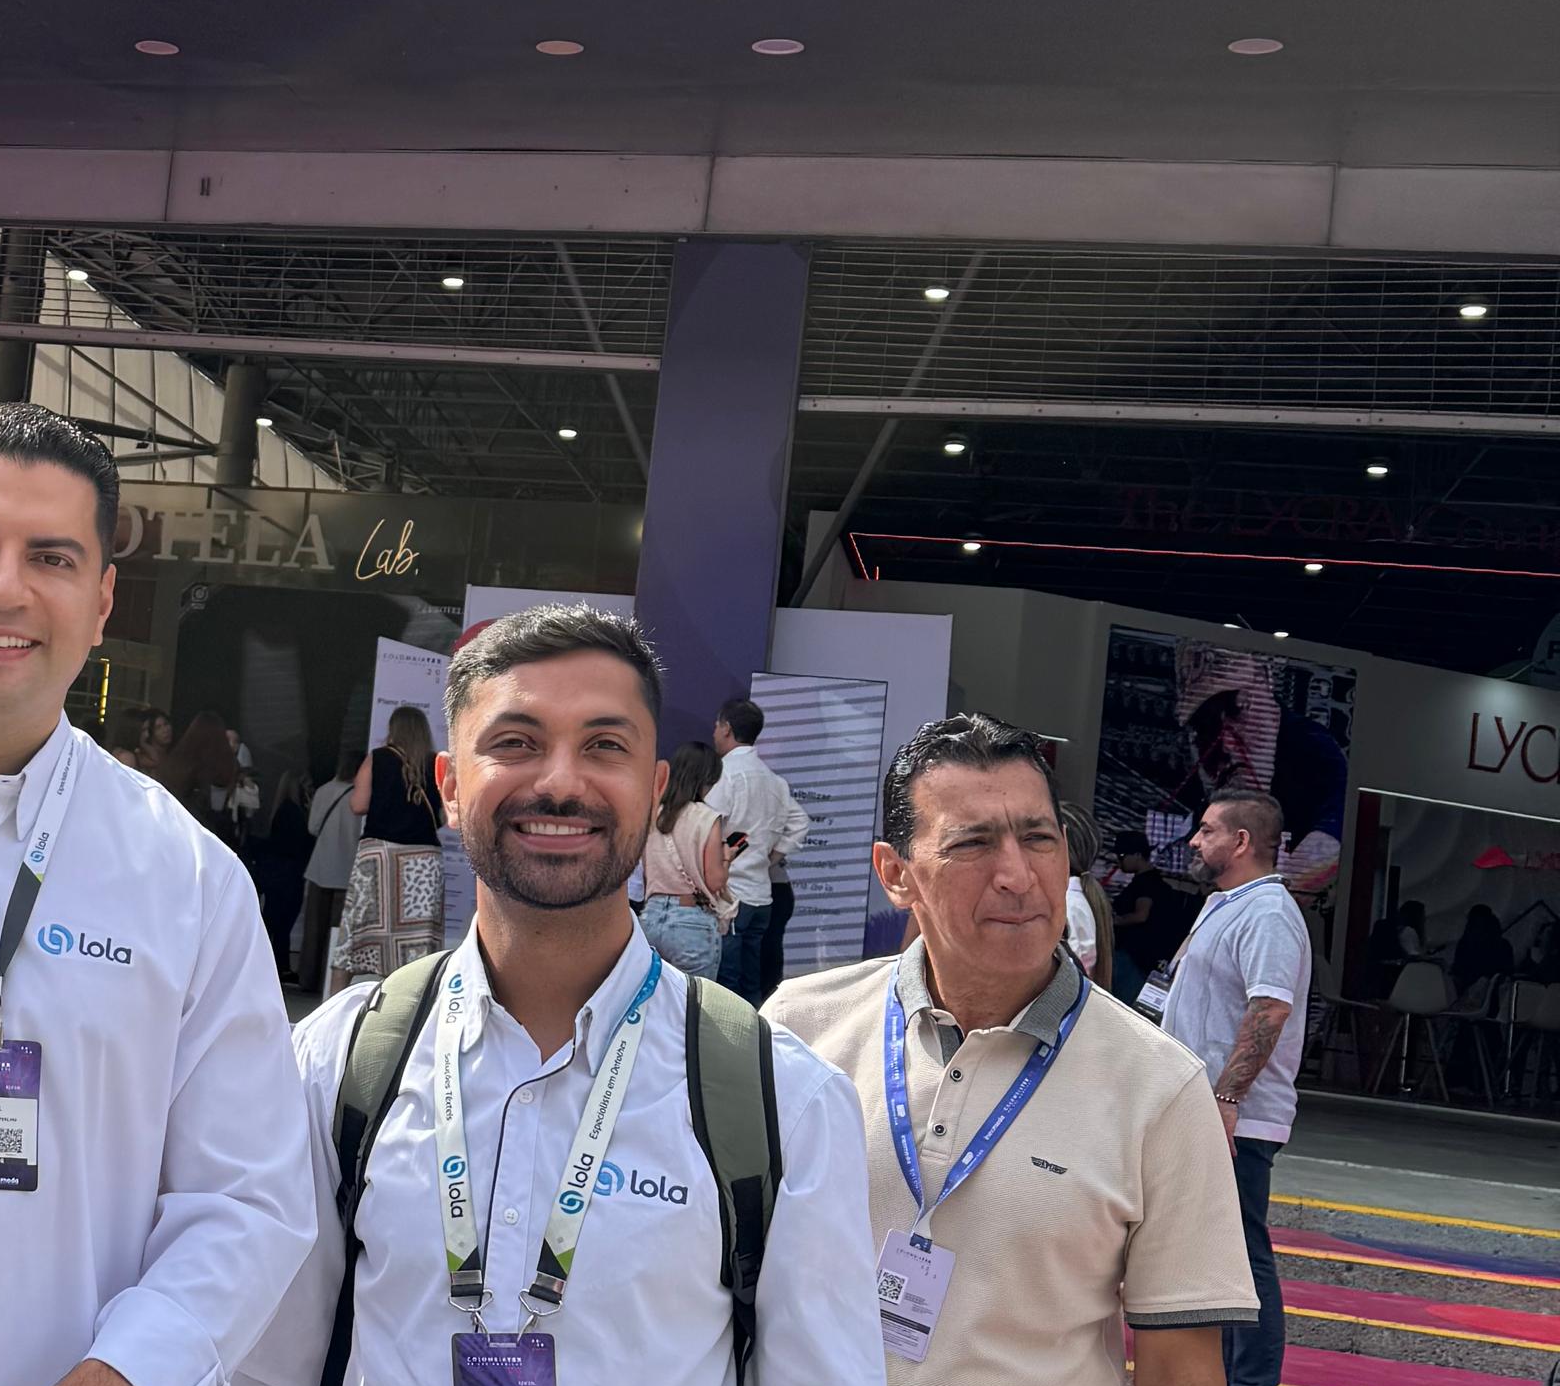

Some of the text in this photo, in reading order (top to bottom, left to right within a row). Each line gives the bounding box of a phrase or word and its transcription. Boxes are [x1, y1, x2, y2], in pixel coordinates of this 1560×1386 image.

[1467, 711, 1560, 784] LYC
[37, 832, 50, 851] lola
[78, 933, 132, 965] lola
[447, 996, 464, 1024] lola
[589, 1089, 613, 1140] Especialista
[570, 1153, 595, 1190] lola
[630, 1170, 689, 1205] lola
[448, 1181, 464, 1219] lola
